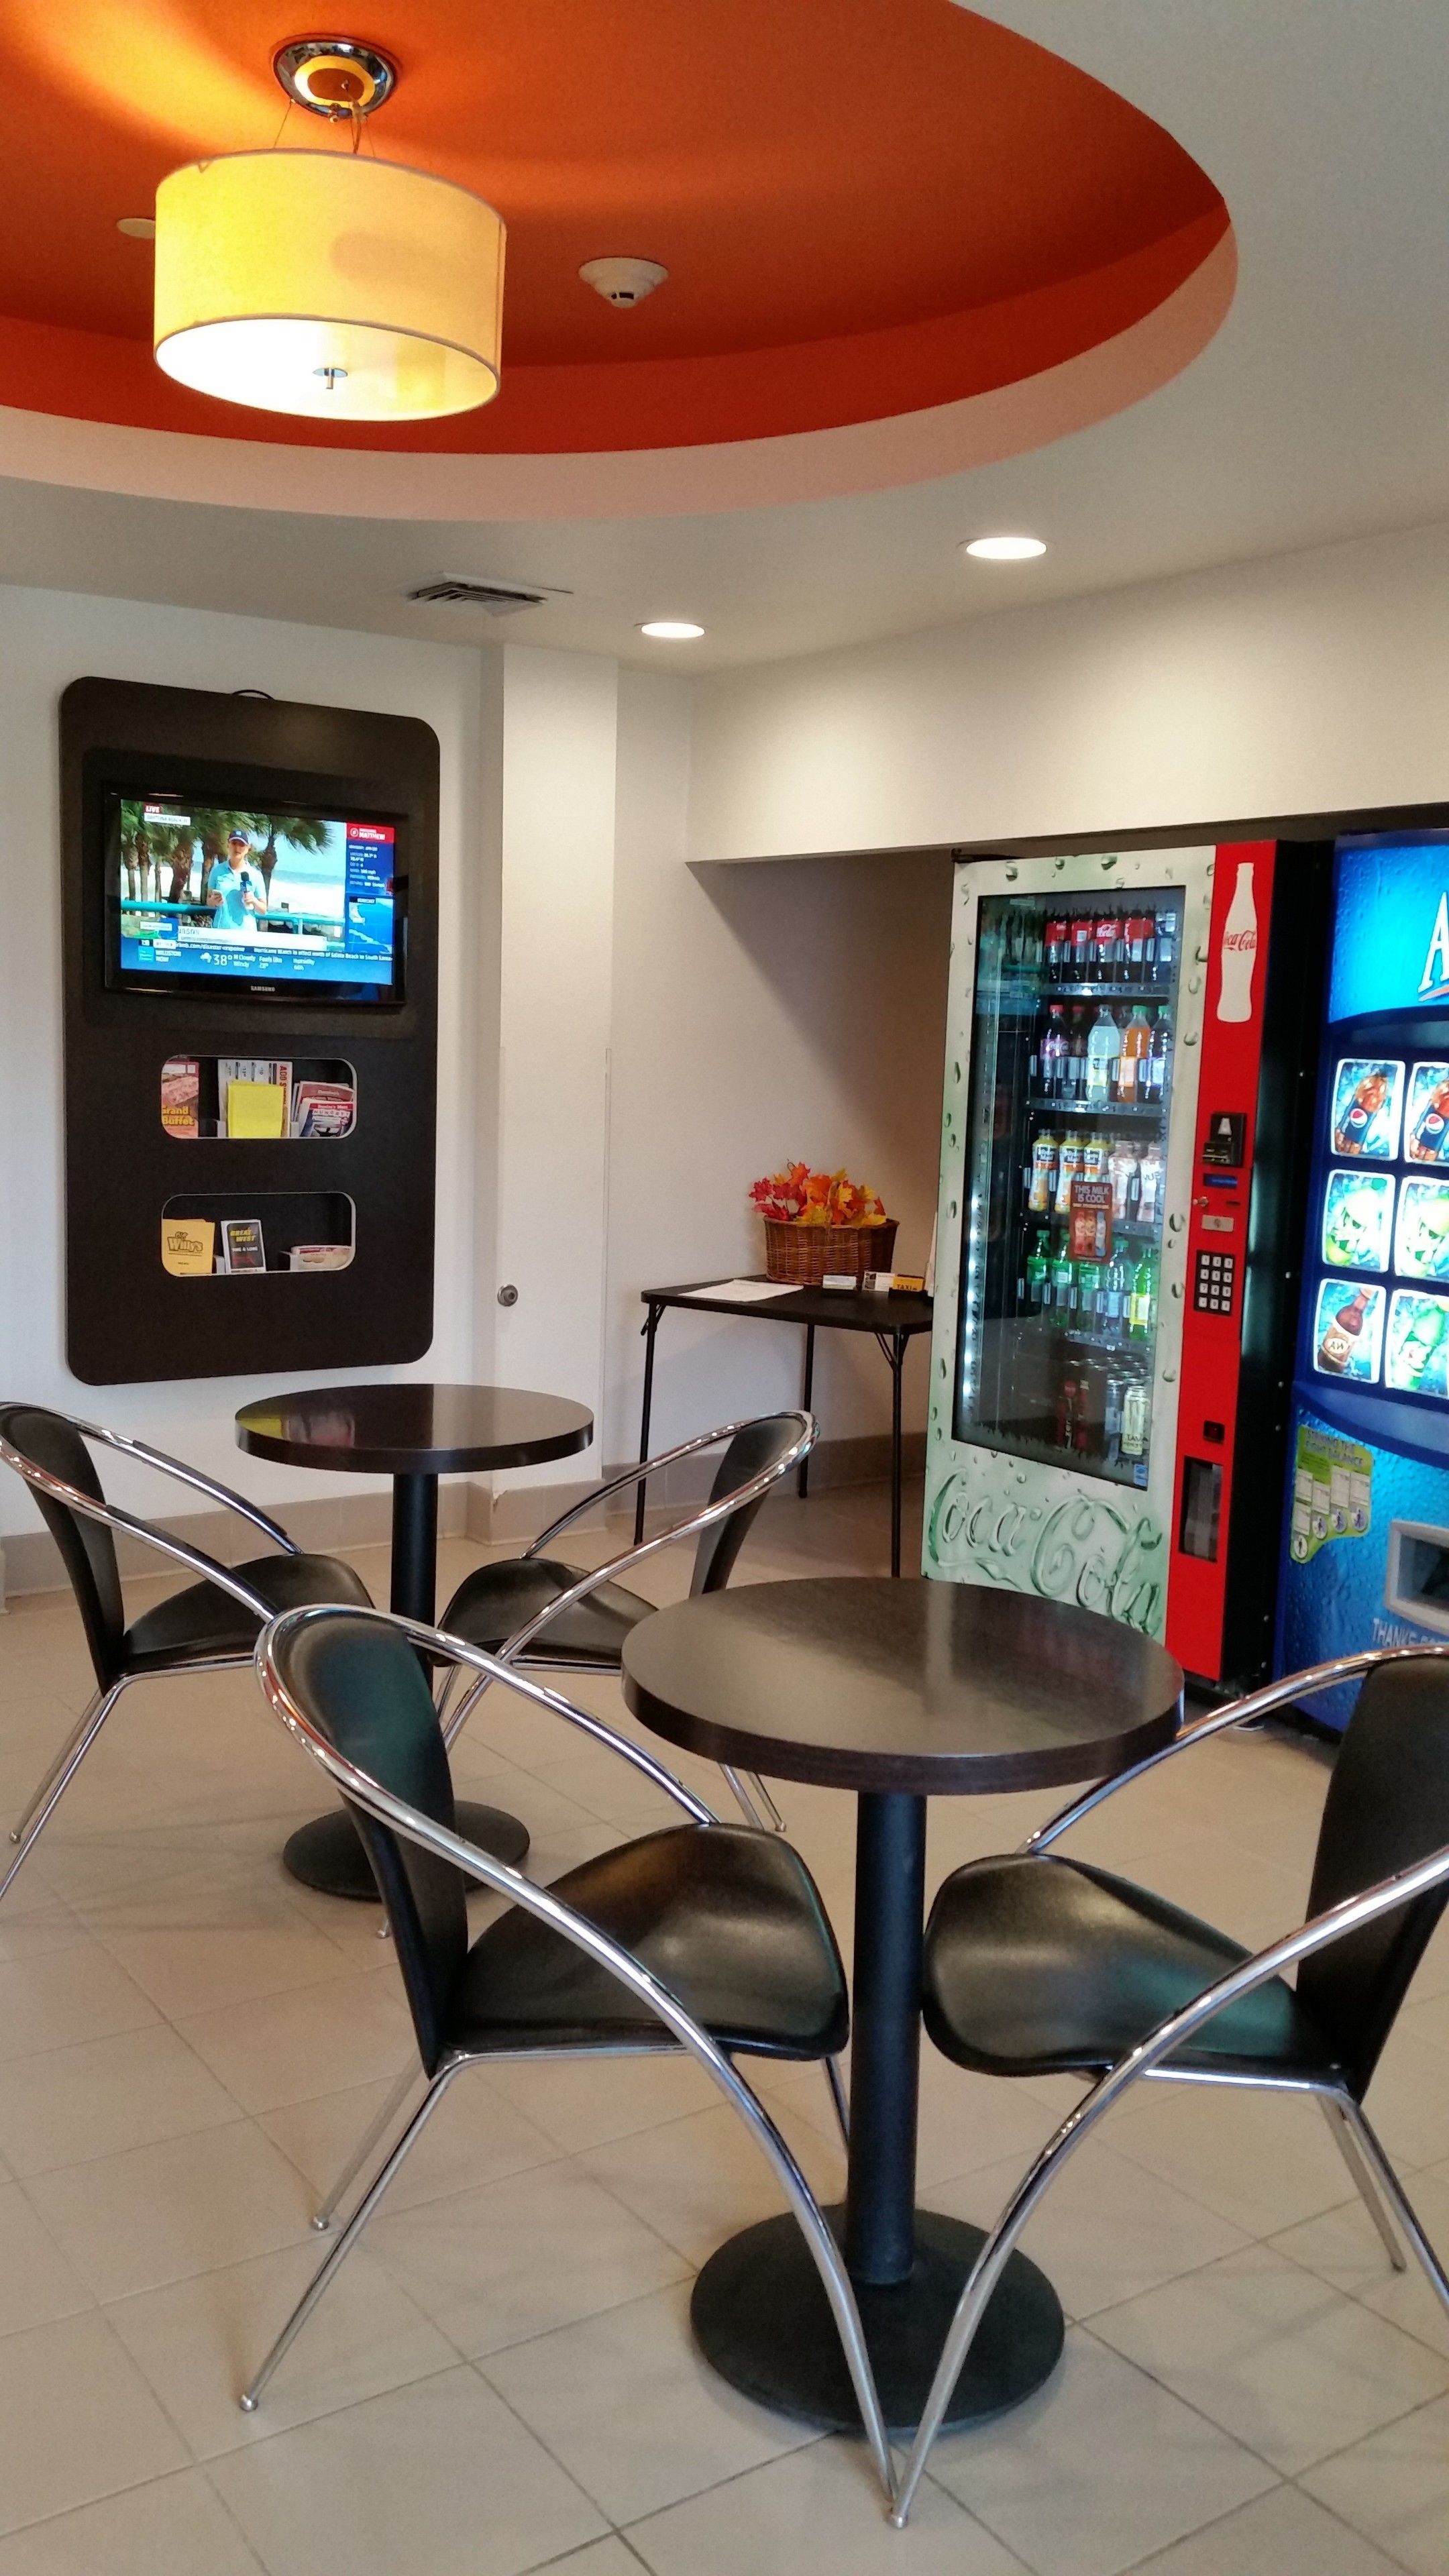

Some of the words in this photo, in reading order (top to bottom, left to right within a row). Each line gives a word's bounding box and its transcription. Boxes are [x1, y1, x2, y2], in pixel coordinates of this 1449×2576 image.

[145, 805, 160, 813] LIVE
[162, 1116, 195, 1126] Buffet
[1075, 1185, 1091, 1195] THIS
[1091, 1186, 1110, 1195] MILK
[1077, 1194, 1085, 1202] IS
[1085, 1194, 1106, 1203] COOL
